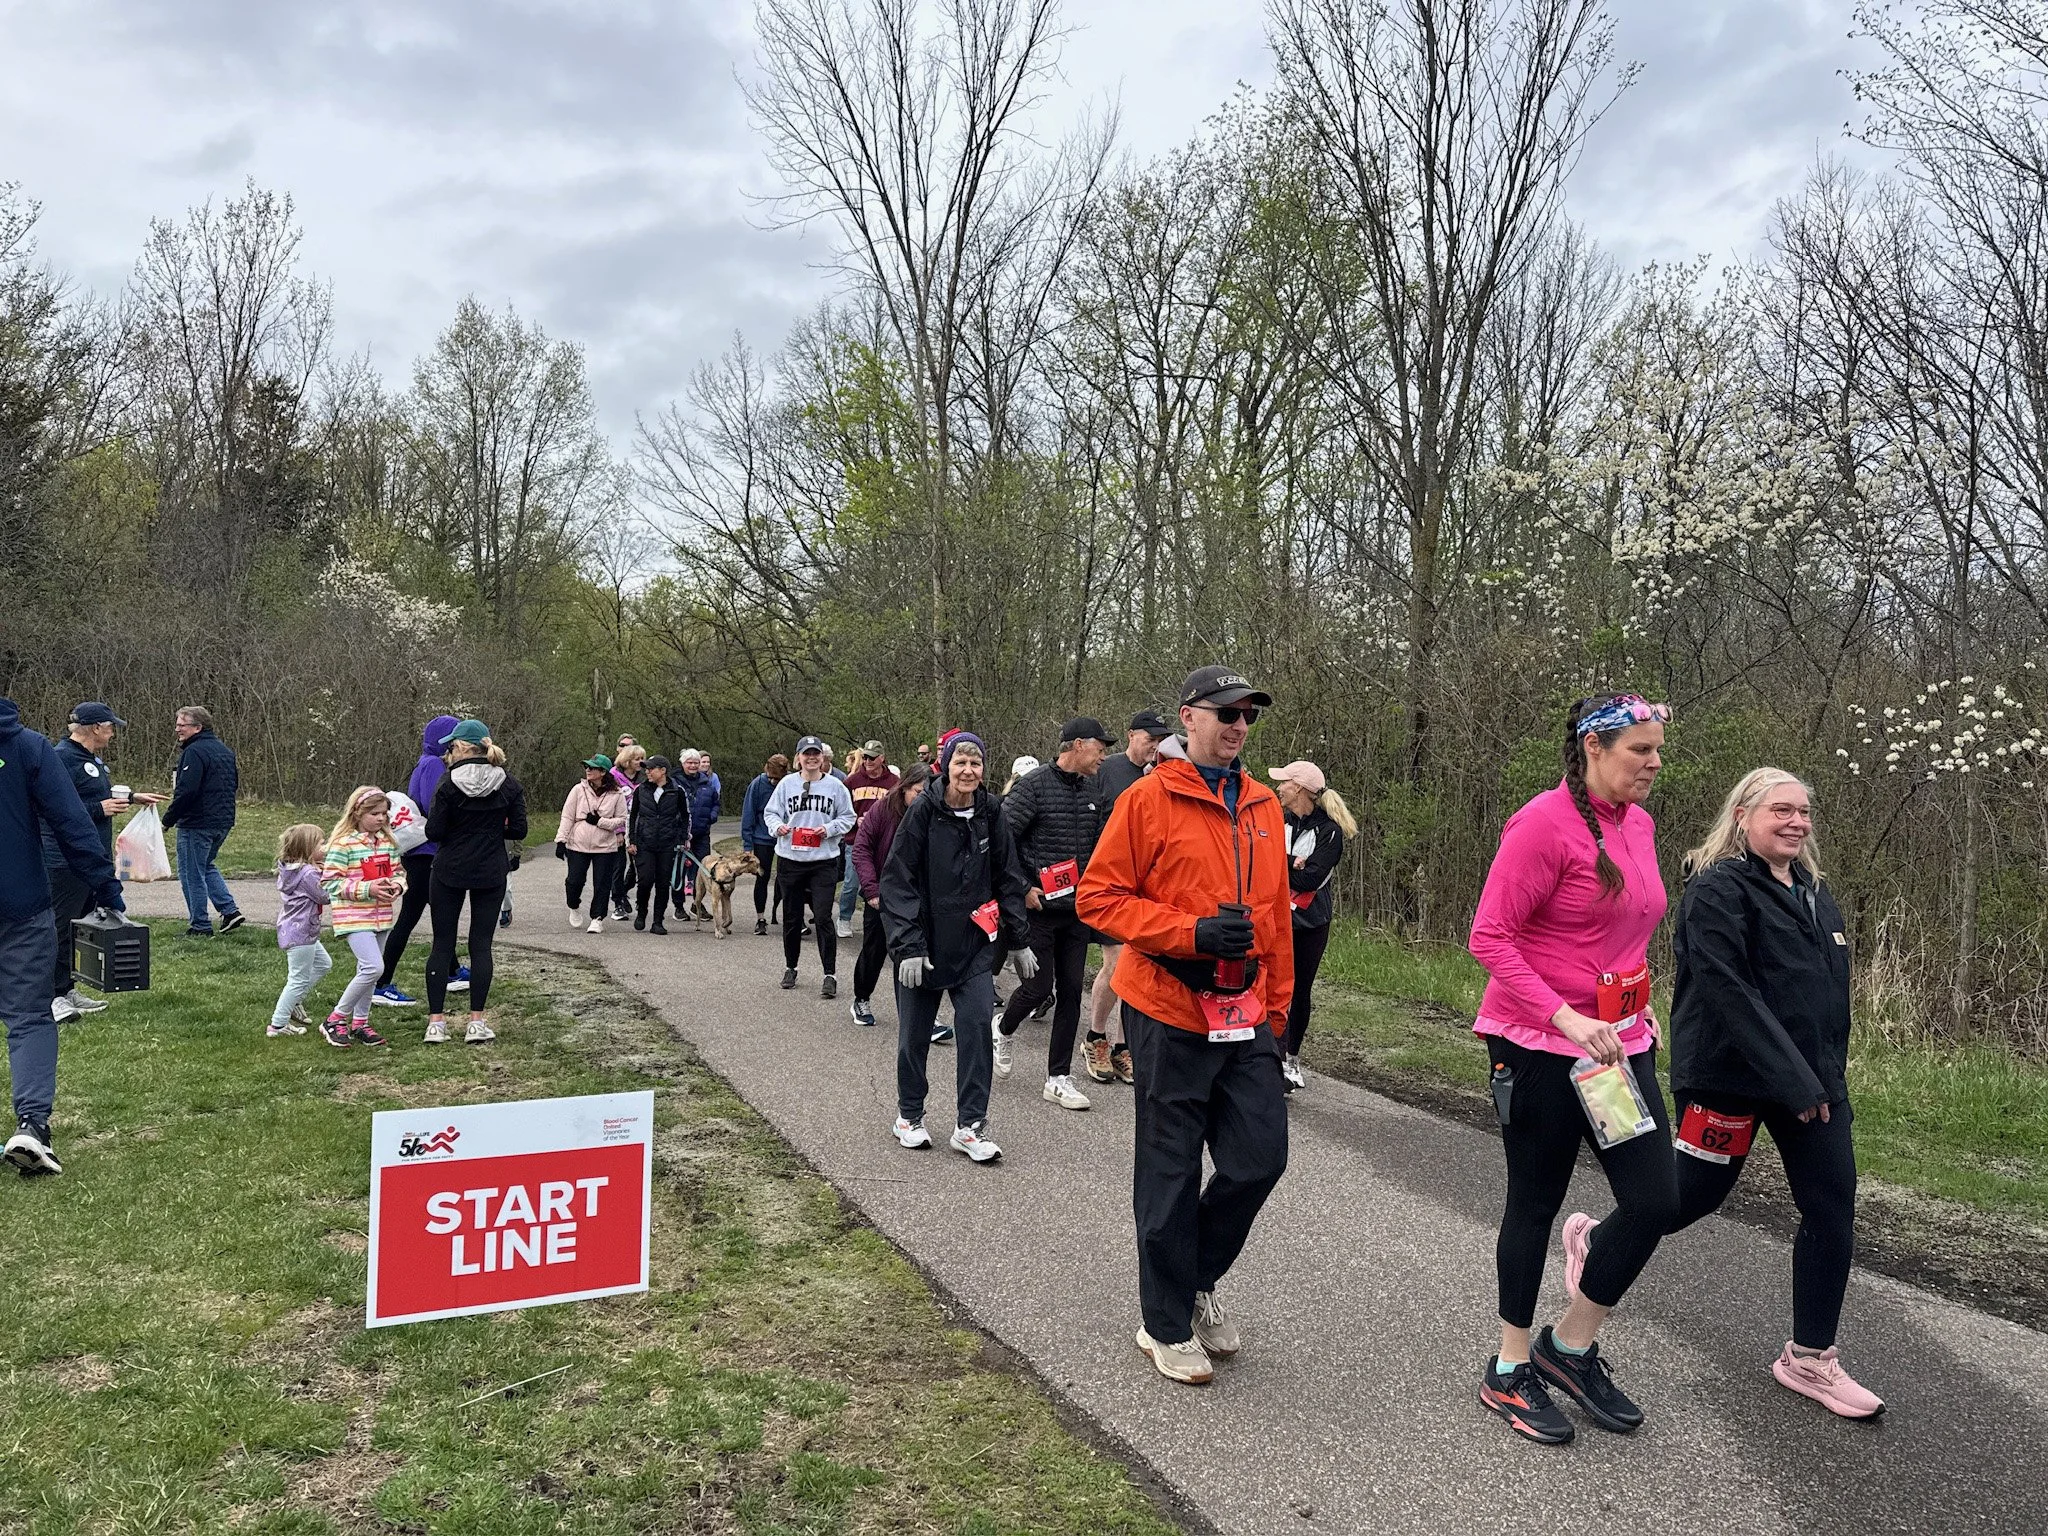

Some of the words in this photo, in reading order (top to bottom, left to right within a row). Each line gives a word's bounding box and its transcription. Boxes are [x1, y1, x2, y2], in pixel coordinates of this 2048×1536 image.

[788, 795, 834, 815] SEATTLE
[801, 834, 813, 846] 33
[1054, 872, 1071, 888] 58
[1620, 987, 1638, 1016] 21
[1218, 1005, 1250, 1026] 22
[1702, 1127, 1734, 1151] 62
[425, 1176, 609, 1235] START
[451, 1222, 577, 1277] LINE
